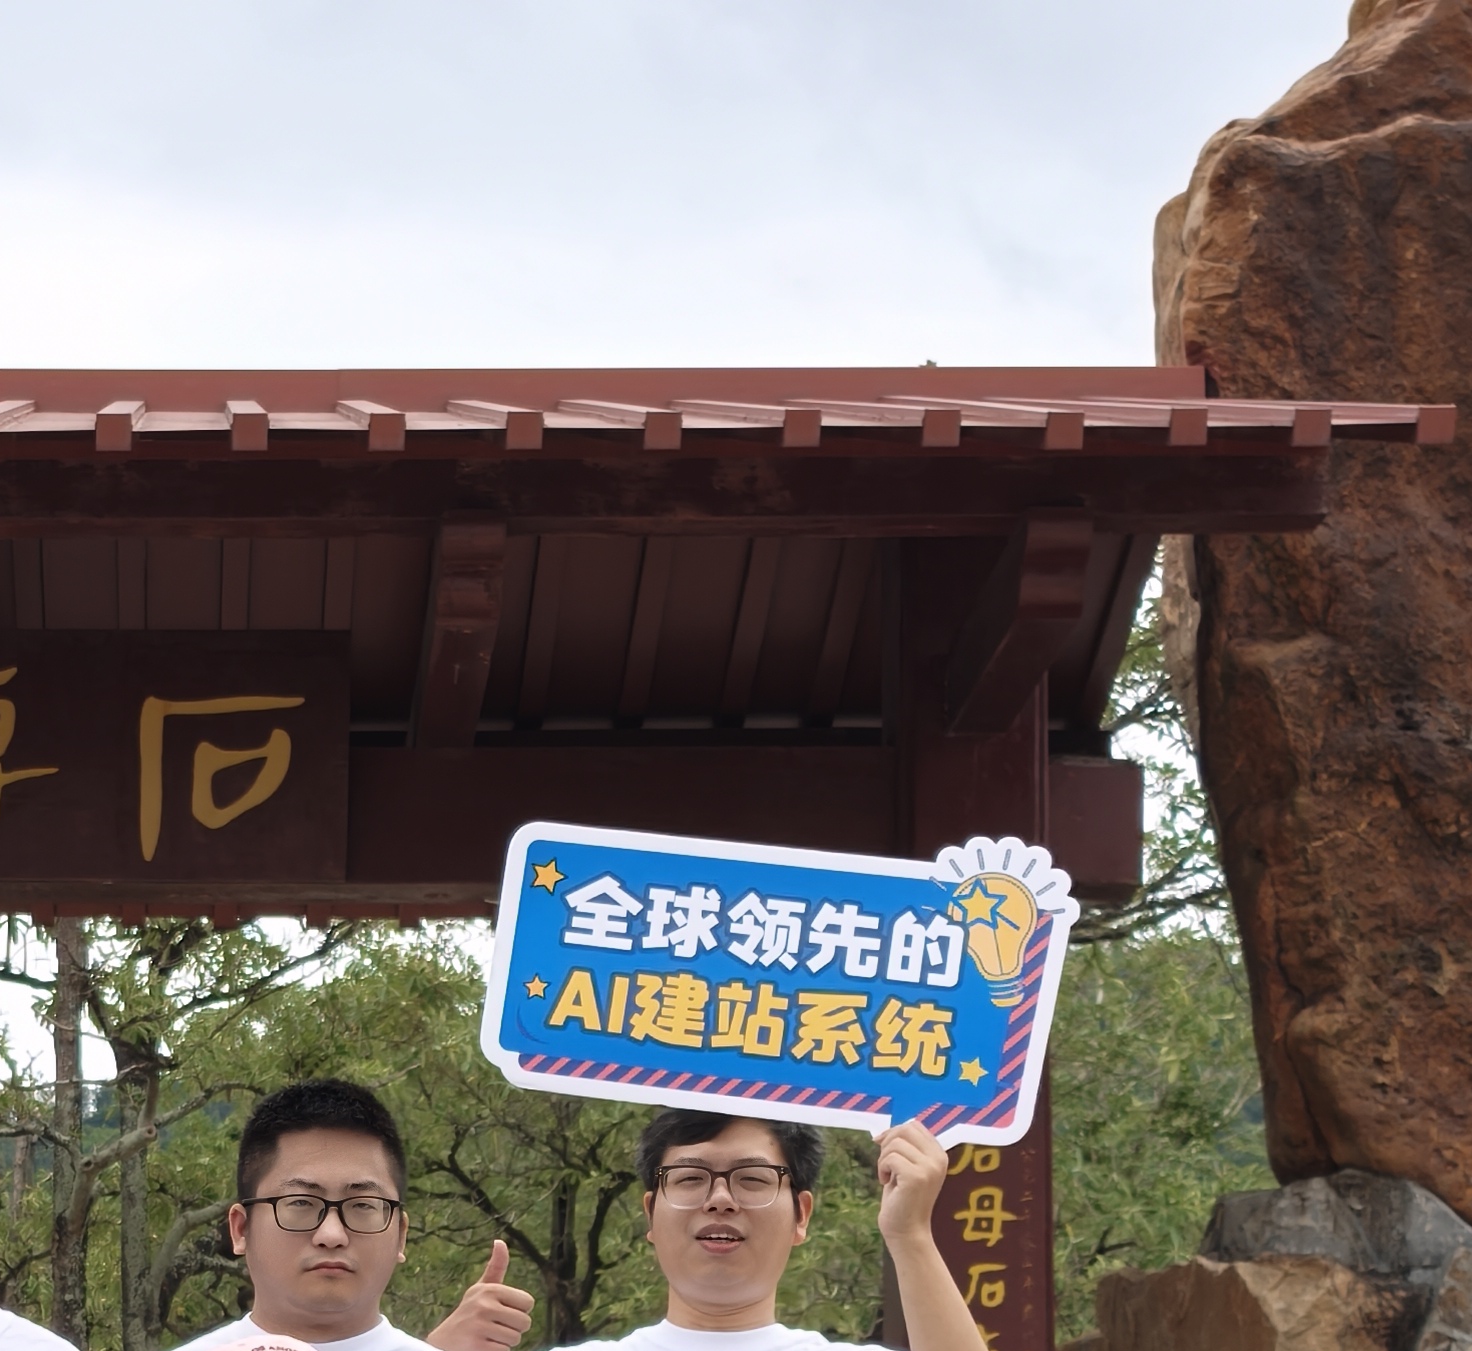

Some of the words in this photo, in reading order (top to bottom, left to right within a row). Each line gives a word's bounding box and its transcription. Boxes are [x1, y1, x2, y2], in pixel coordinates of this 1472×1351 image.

[561, 873, 967, 989] 全球领先的
[547, 969, 955, 1078] AI建站系统
